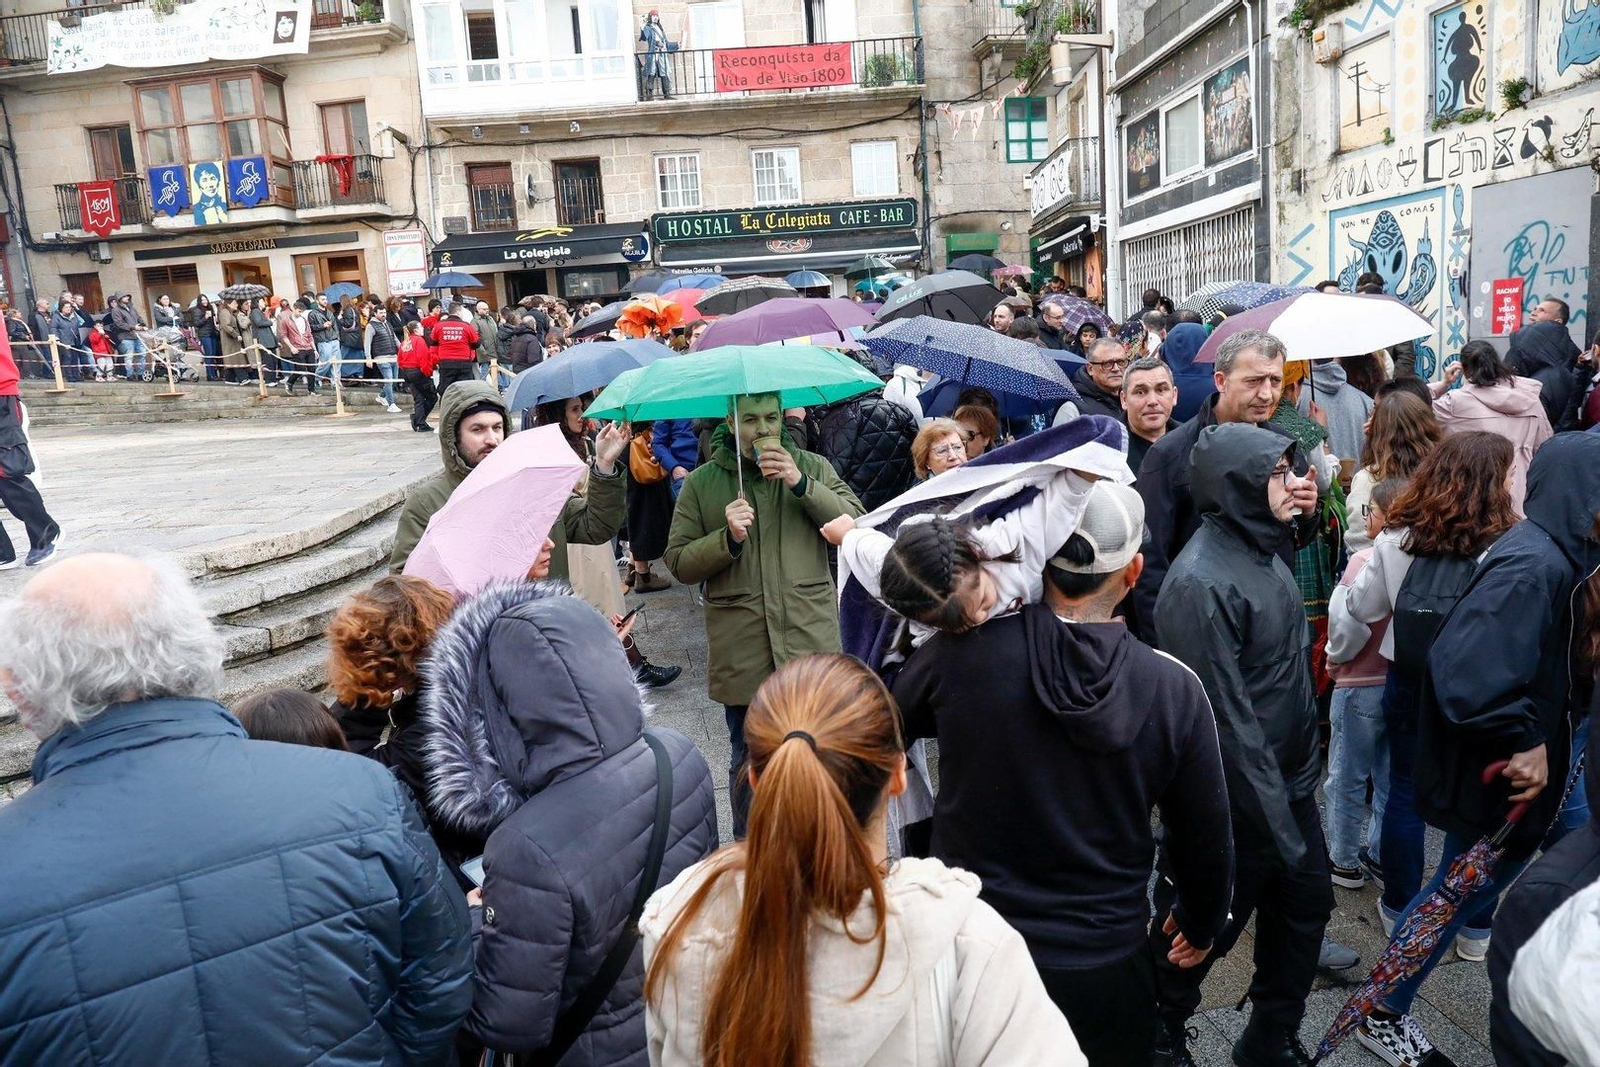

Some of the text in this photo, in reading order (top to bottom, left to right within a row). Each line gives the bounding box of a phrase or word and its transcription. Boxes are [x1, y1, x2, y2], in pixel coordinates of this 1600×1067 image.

[129, 12, 163, 25] Castia
[719, 48, 841, 70] Reconquista da
[757, 72, 774, 85] de
[812, 68, 846, 83] 1809
[1399, 203, 1435, 217] COMAS
[667, 217, 733, 237] HOSTAL
[740, 213, 760, 230] La
[765, 211, 832, 230] Colegiata
[839, 209, 871, 225] CAFE
[880, 207, 904, 222] BAR
[504, 251, 517, 260] La
